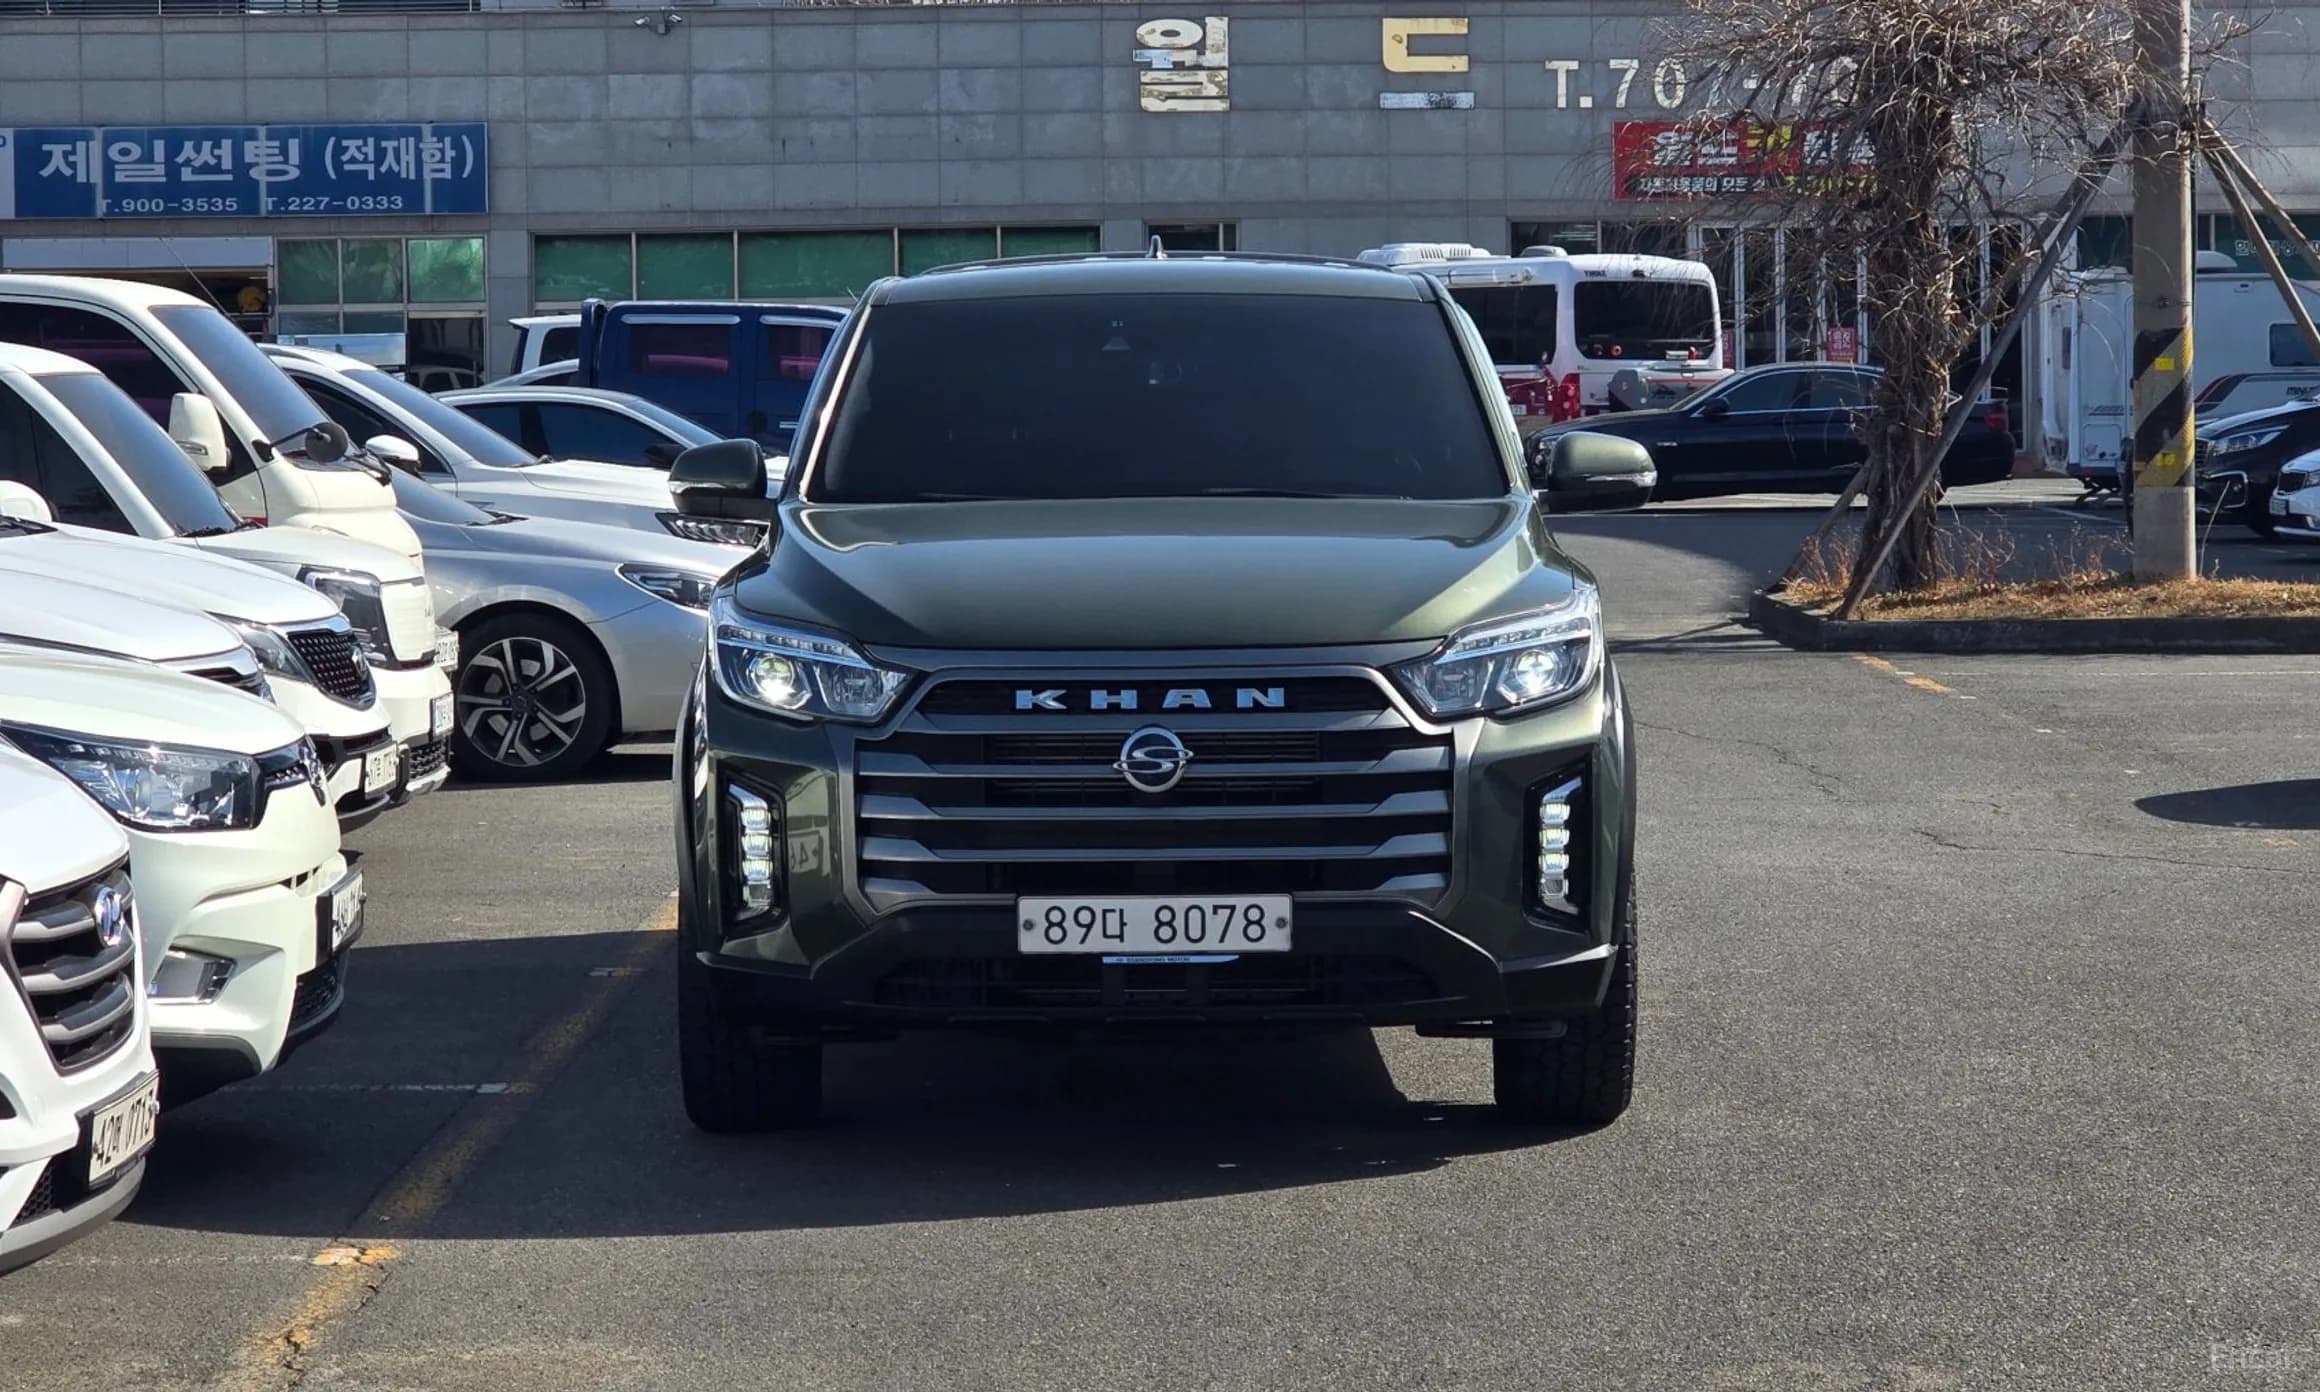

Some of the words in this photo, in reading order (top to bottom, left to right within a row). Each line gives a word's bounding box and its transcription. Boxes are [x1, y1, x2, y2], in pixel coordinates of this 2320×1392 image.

[39, 138, 301, 183] 제일썬팅
[324, 134, 475, 181] (적재함)
[99, 197, 239, 214] T.900-3535
[264, 195, 404, 212] T.227-0333
[1015, 687, 1285, 710] KHAN
[1044, 905, 1127, 944] 89다
[1153, 904, 1266, 944] 8078
